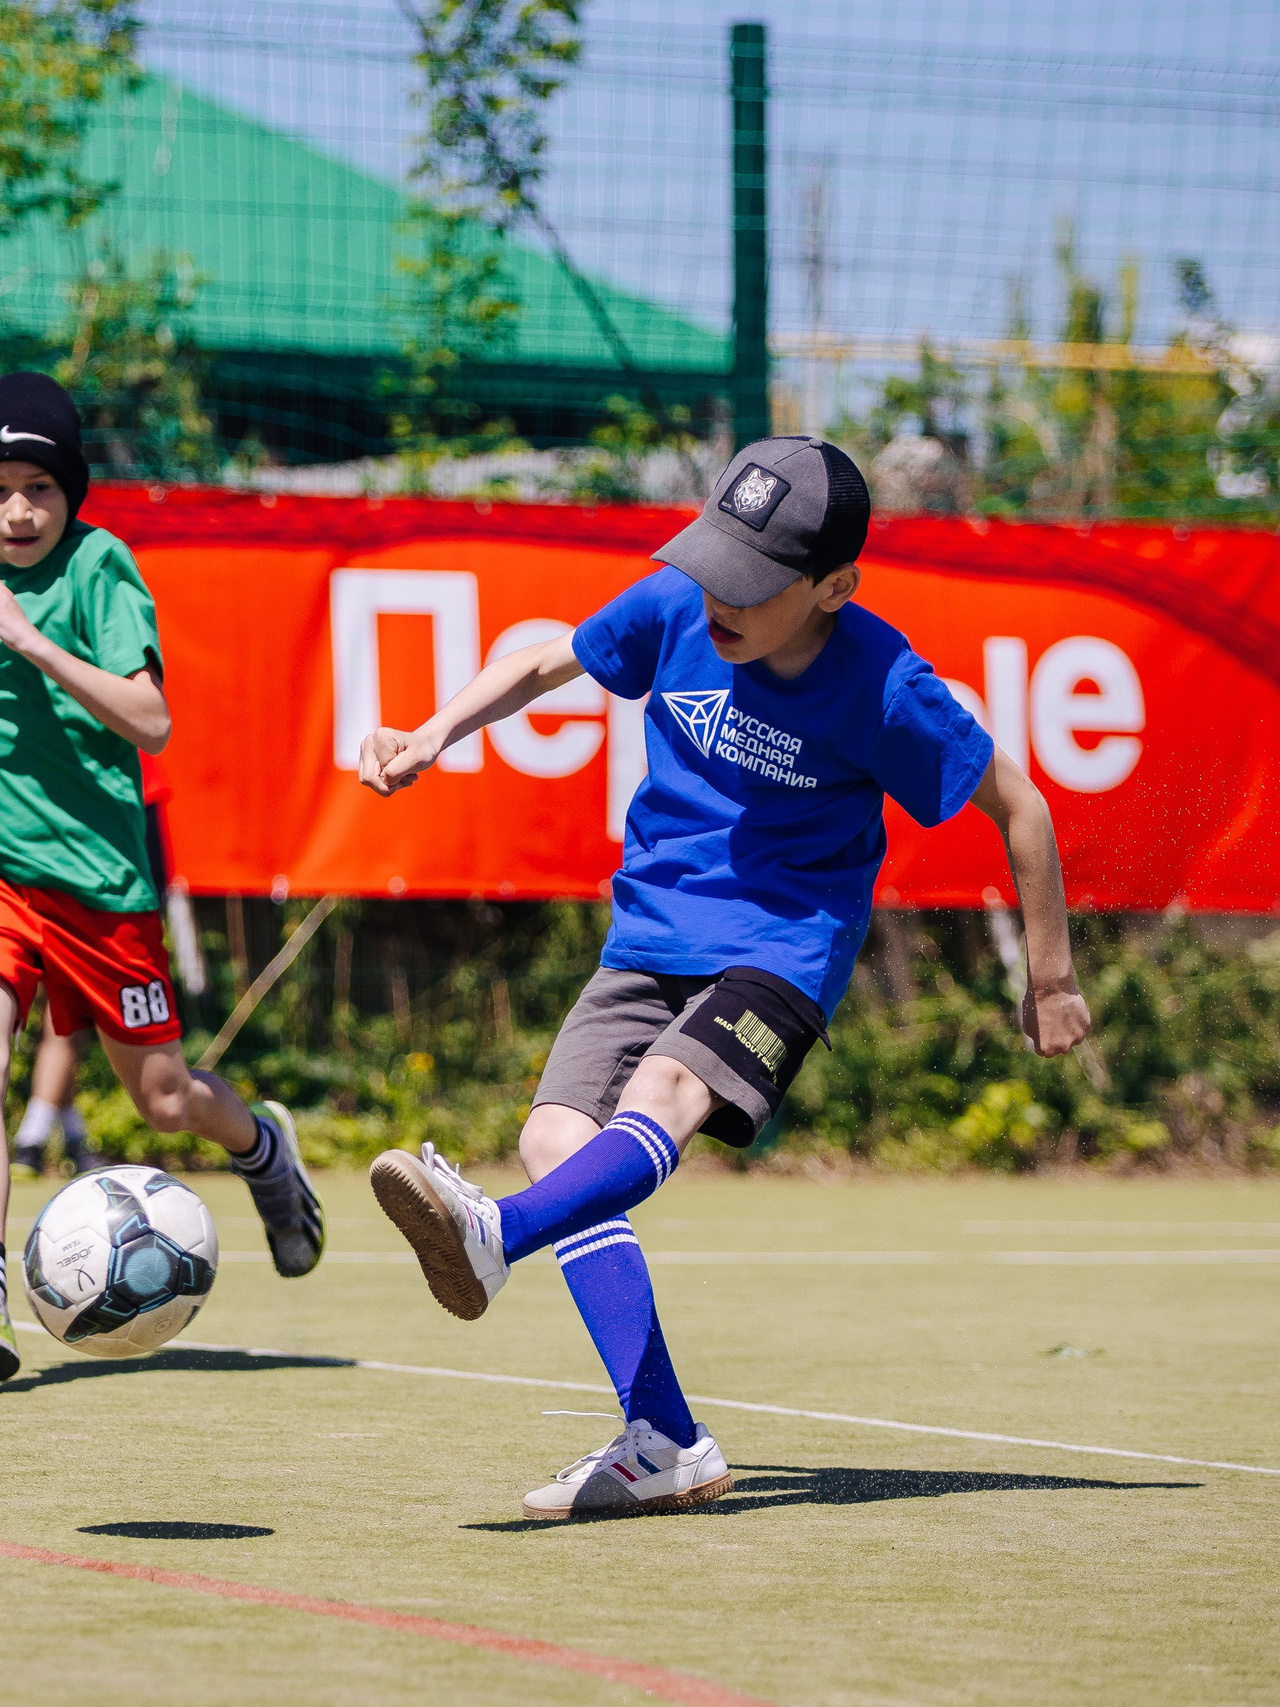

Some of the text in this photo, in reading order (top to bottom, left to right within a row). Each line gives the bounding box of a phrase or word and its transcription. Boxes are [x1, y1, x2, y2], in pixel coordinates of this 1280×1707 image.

[330, 567, 1146, 844] Пее
[720, 723, 795, 768] МЕДНАЯ
[725, 706, 802, 754] РУССКАЯ
[715, 740, 818, 788] КОМПАНИЯ
[120, 980, 170, 1029] 88
[713, 1016, 733, 1031] MAD
[55, 1244, 95, 1267] JÖGEL
